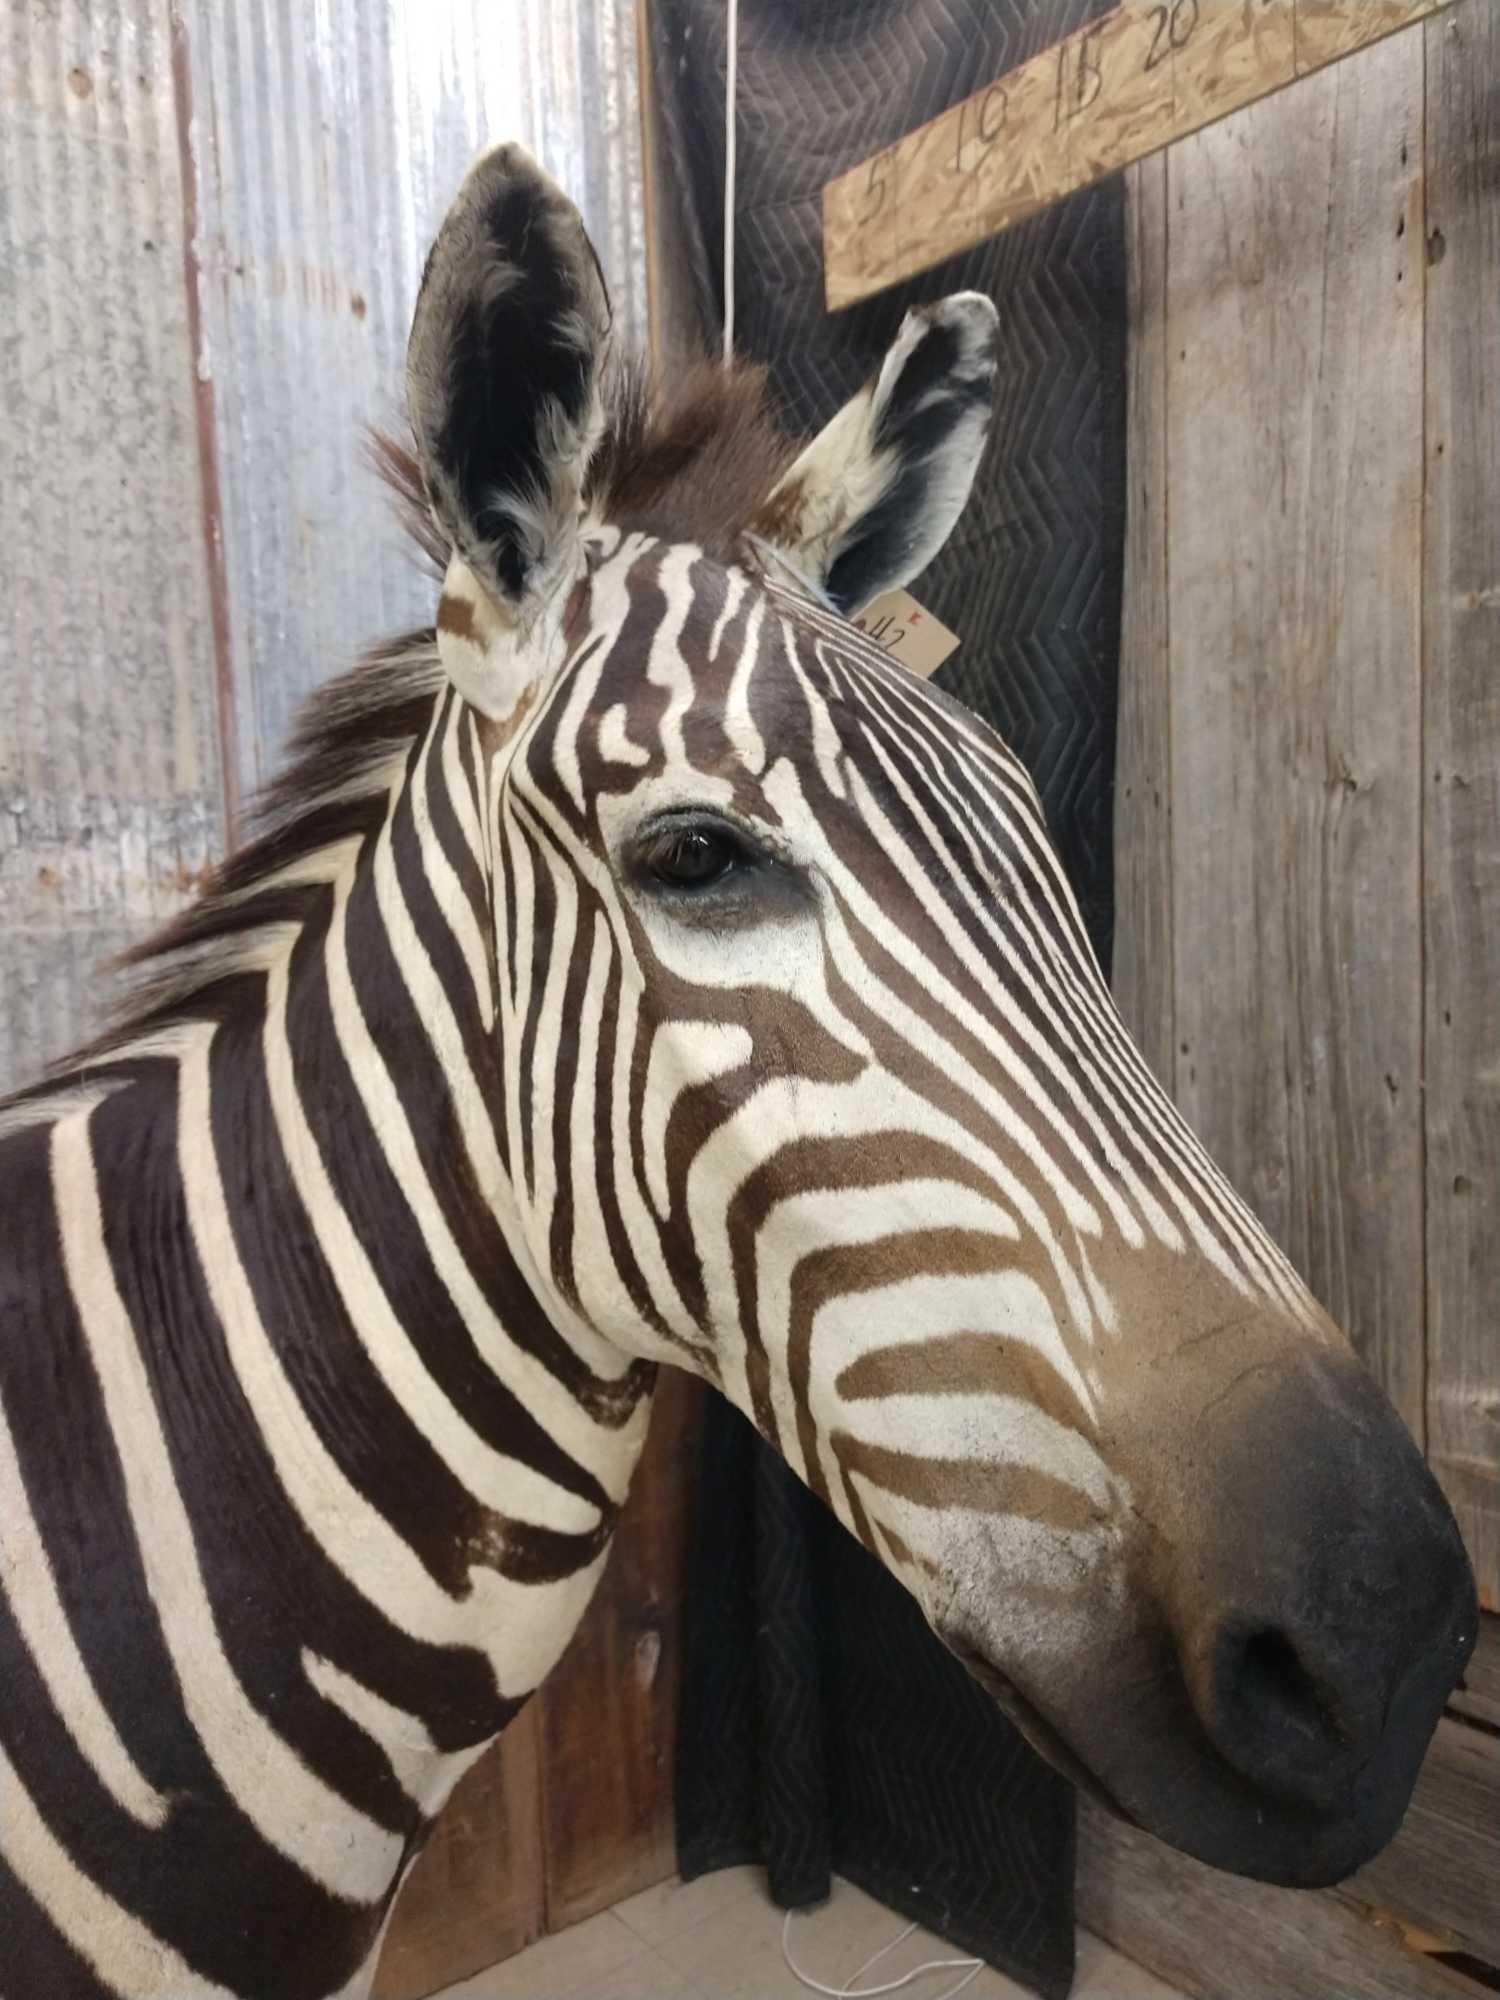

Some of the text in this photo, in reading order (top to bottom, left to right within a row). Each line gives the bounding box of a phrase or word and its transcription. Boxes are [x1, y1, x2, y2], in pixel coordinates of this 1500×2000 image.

[857, 153, 889, 227] 5
[956, 85, 1009, 173] 10
[1143, 0, 1199, 72] 20
